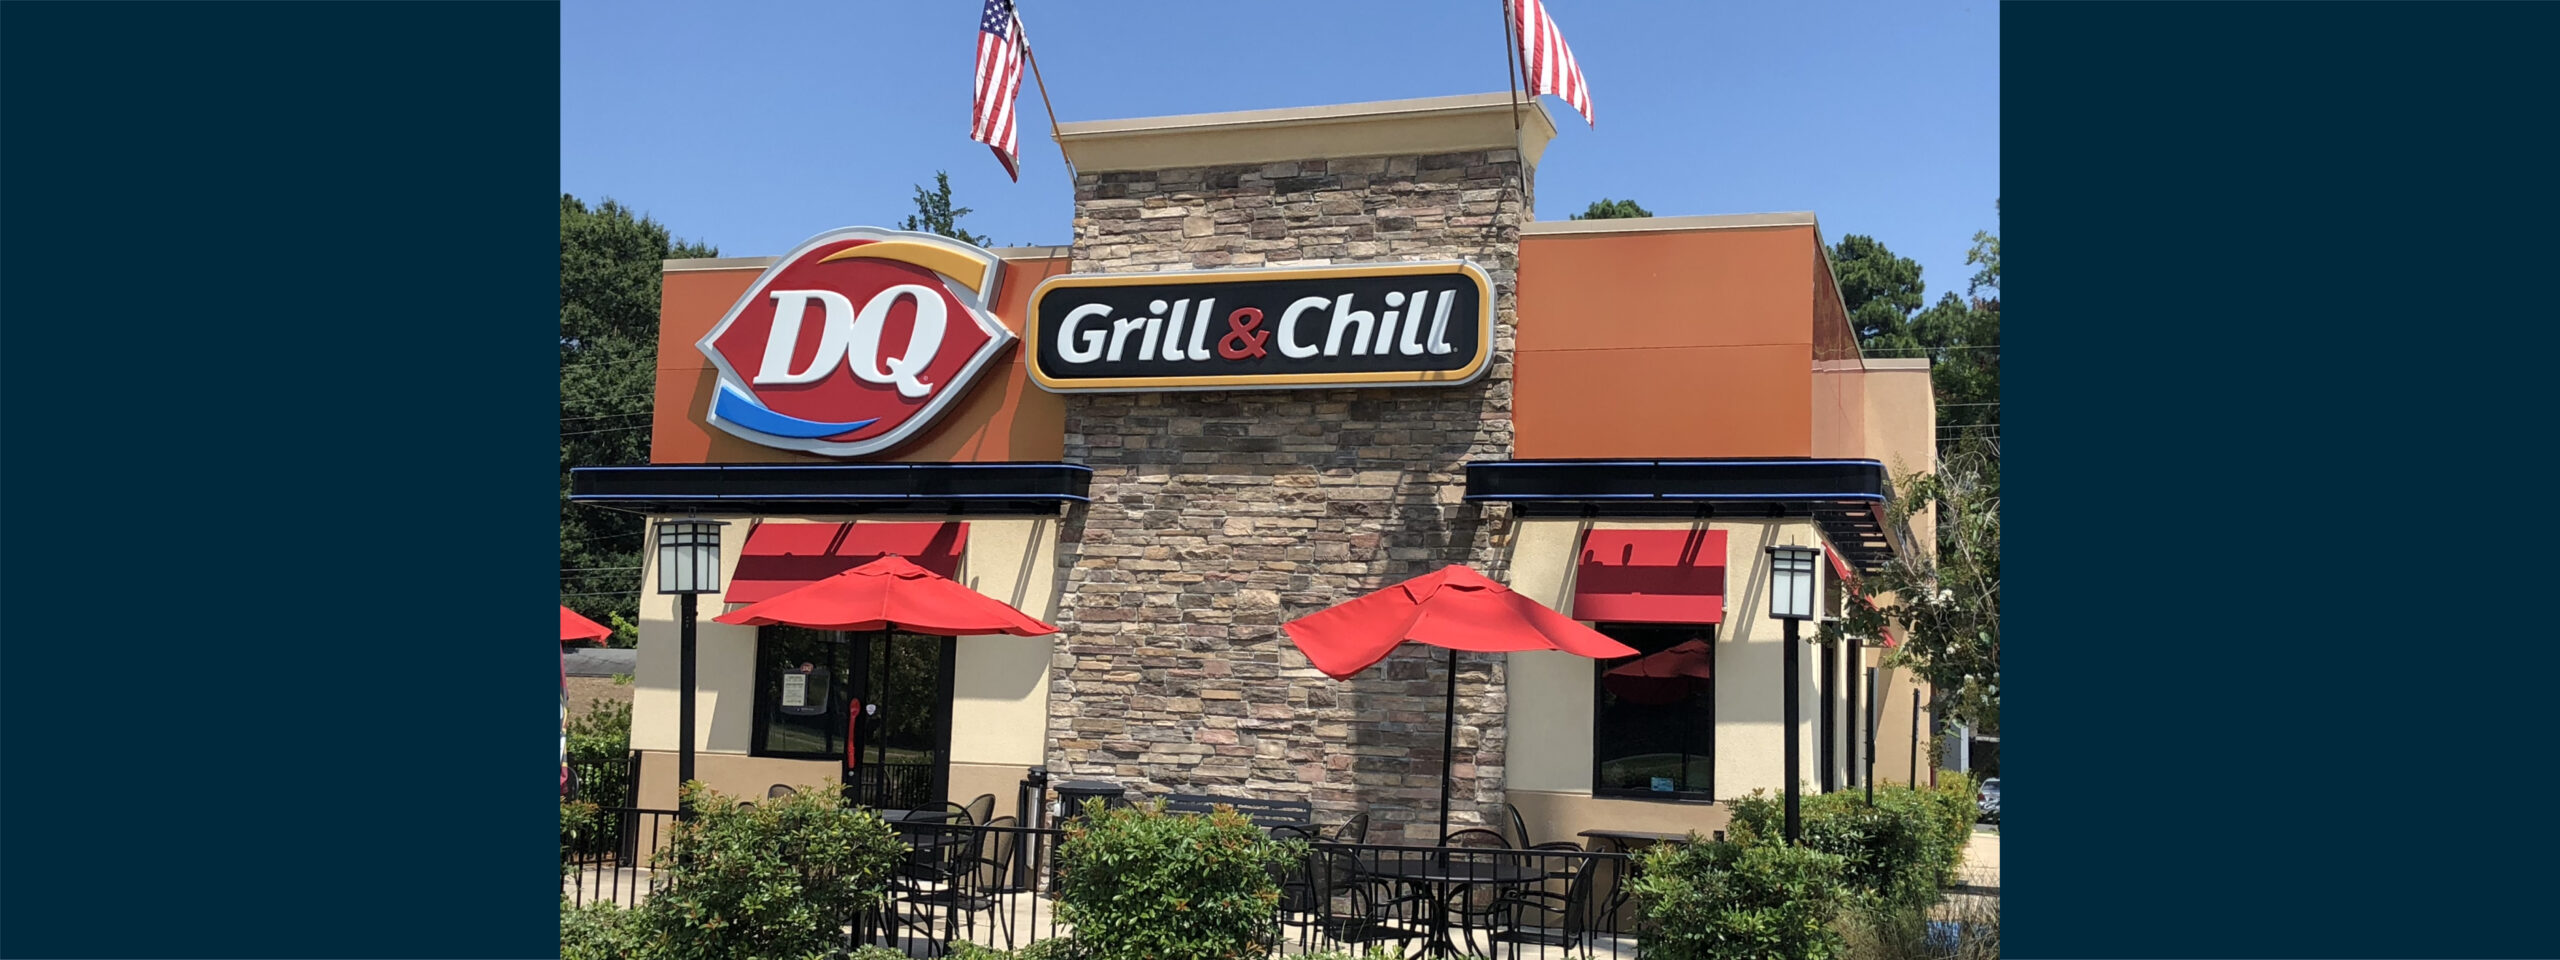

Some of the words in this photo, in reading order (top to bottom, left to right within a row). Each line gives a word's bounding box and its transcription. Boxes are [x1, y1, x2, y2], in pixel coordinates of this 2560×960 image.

[753, 284, 947, 398] DQ
[1056, 298, 1216, 364] Grill
[1217, 306, 1270, 360] &
[1277, 289, 1457, 359] Chill
